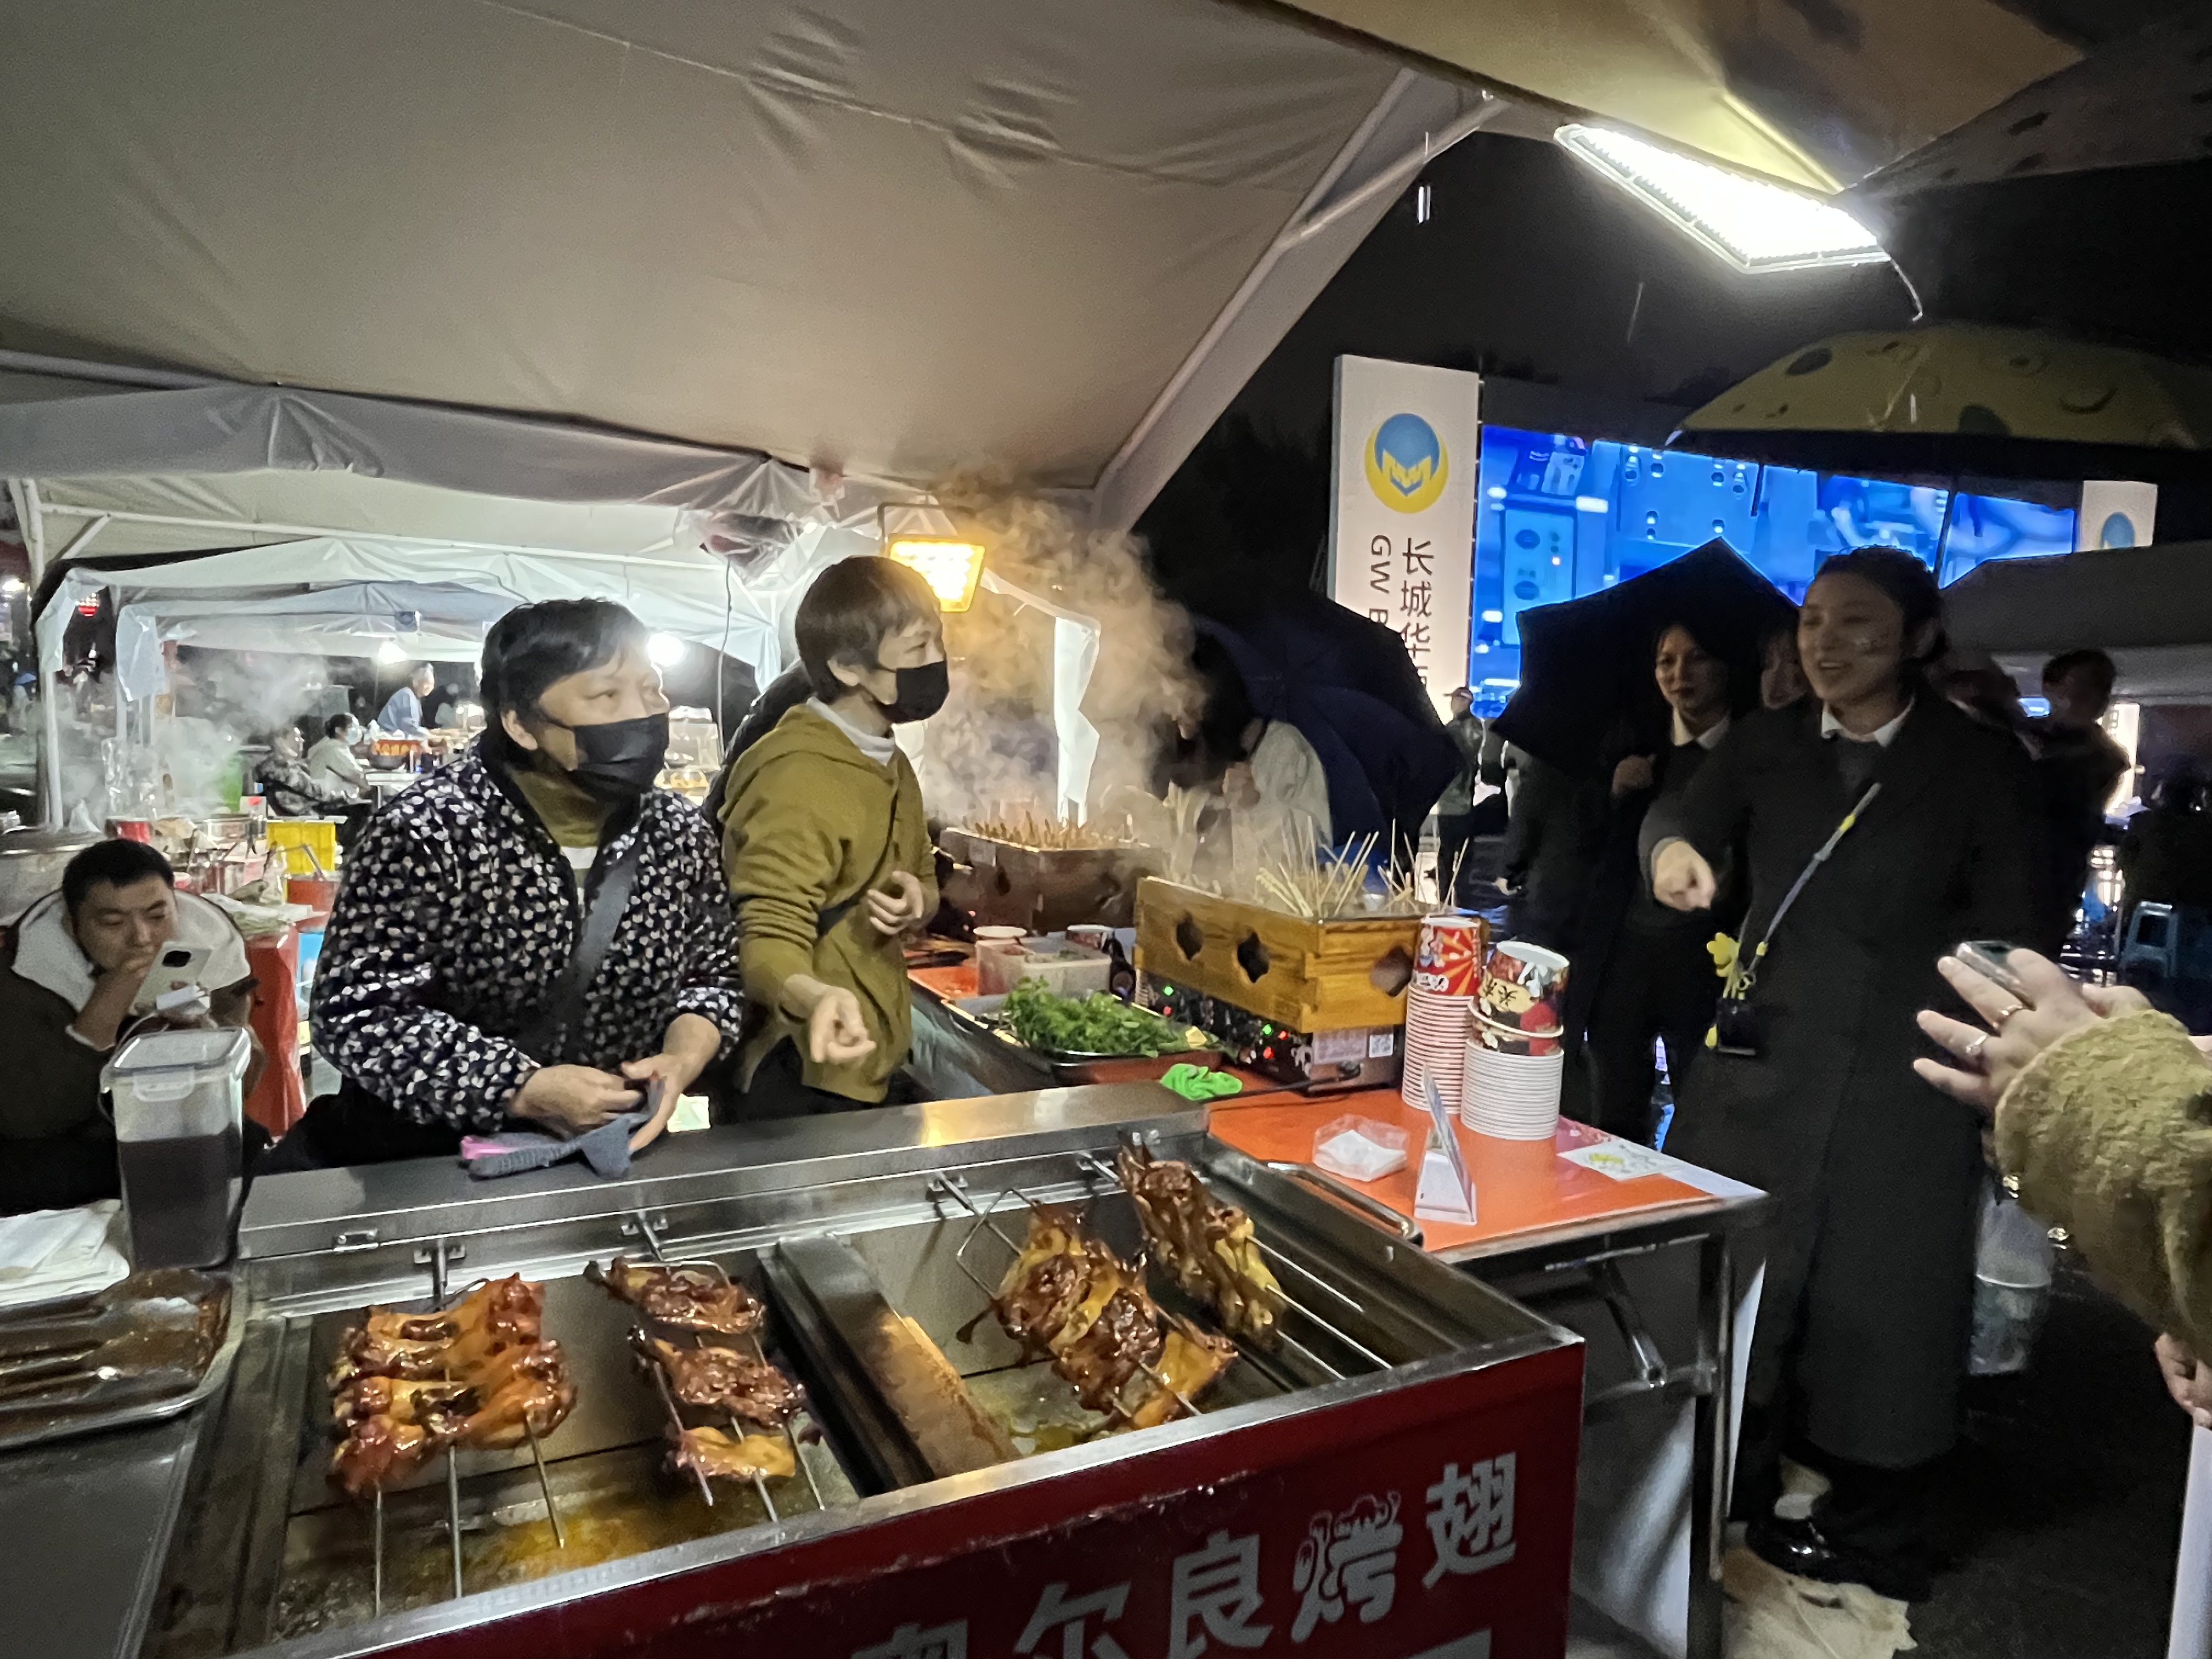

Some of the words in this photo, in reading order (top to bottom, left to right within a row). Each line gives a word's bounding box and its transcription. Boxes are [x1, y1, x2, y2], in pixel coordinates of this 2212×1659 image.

[1369, 534, 1391, 594] GW
[1400, 537, 1435, 686] 长城华
